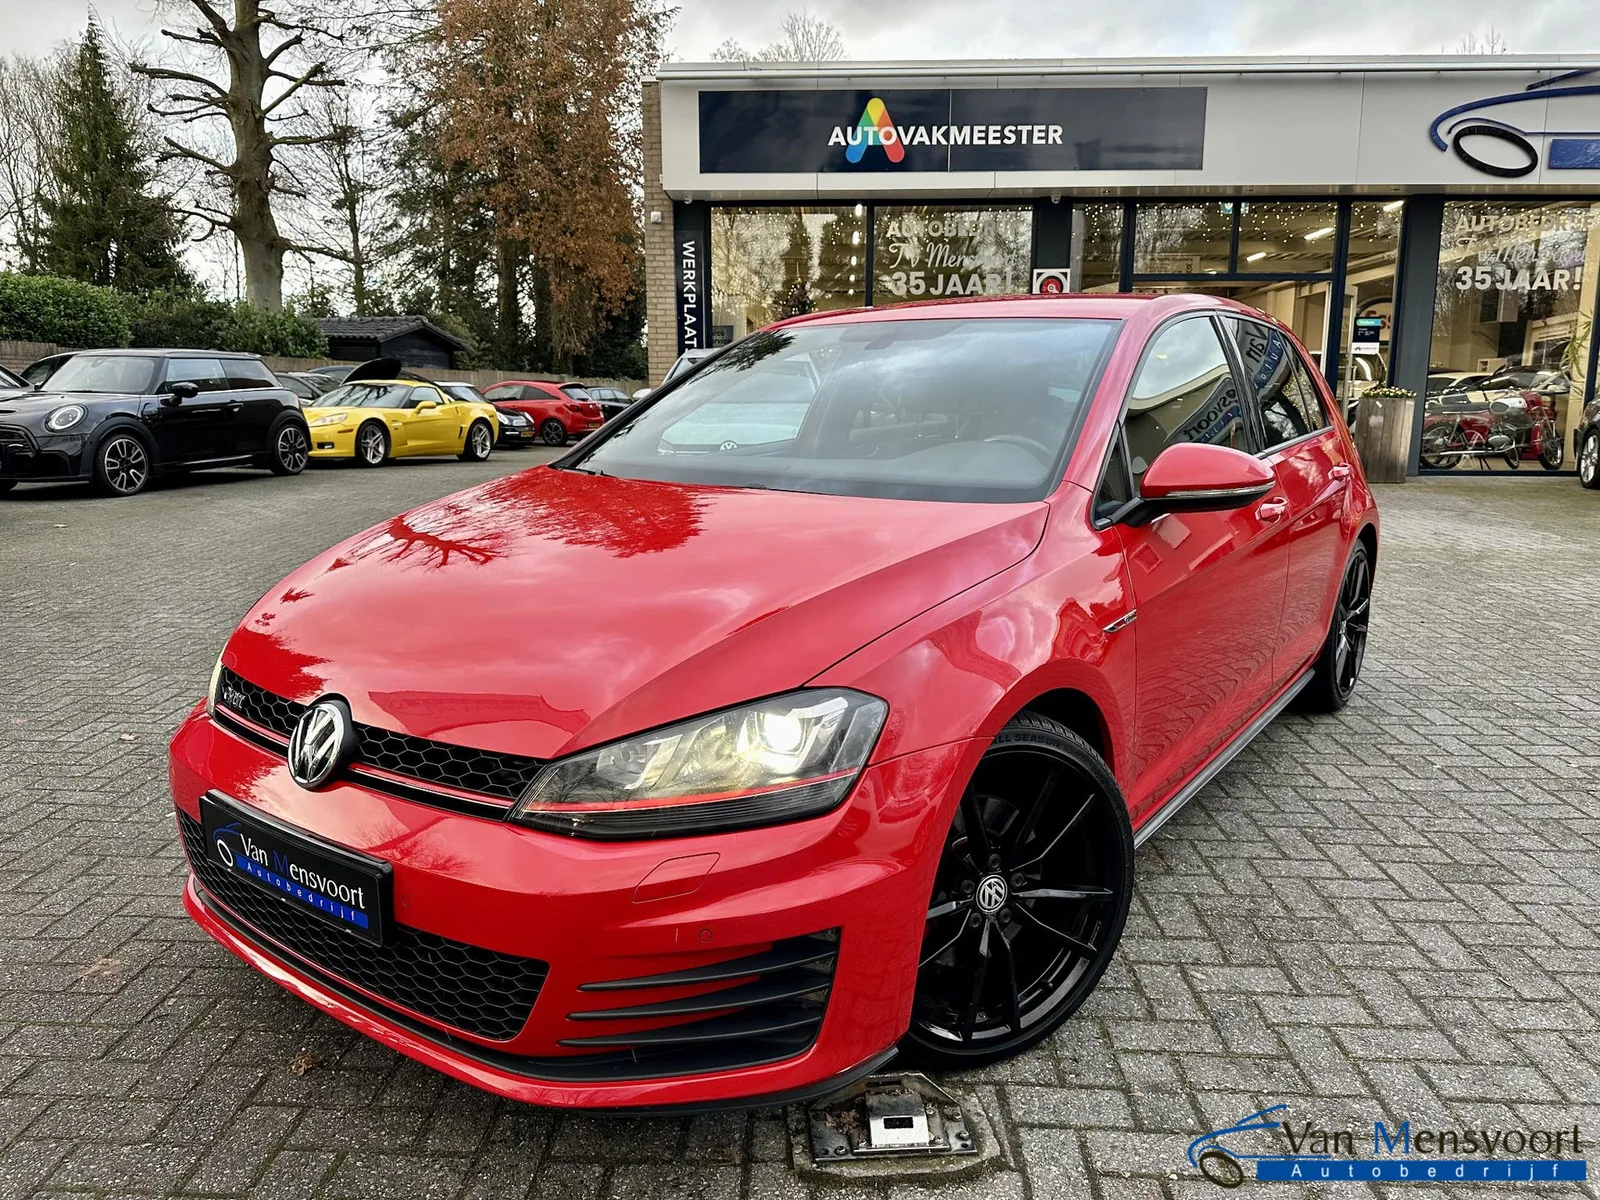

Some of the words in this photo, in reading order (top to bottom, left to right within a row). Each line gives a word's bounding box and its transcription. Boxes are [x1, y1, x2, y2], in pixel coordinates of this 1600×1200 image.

[828, 125, 1063, 146] AUTOVAKMEESTER
[682, 240, 698, 352] WERKPLAAT
[891, 270, 926, 296] 35
[1455, 266, 1492, 291] 35
[1495, 266, 1582, 291] JAAR!
[240, 832, 269, 867] Van
[272, 849, 366, 910] Mensvoort
[246, 861, 355, 921] Autobedrijf
